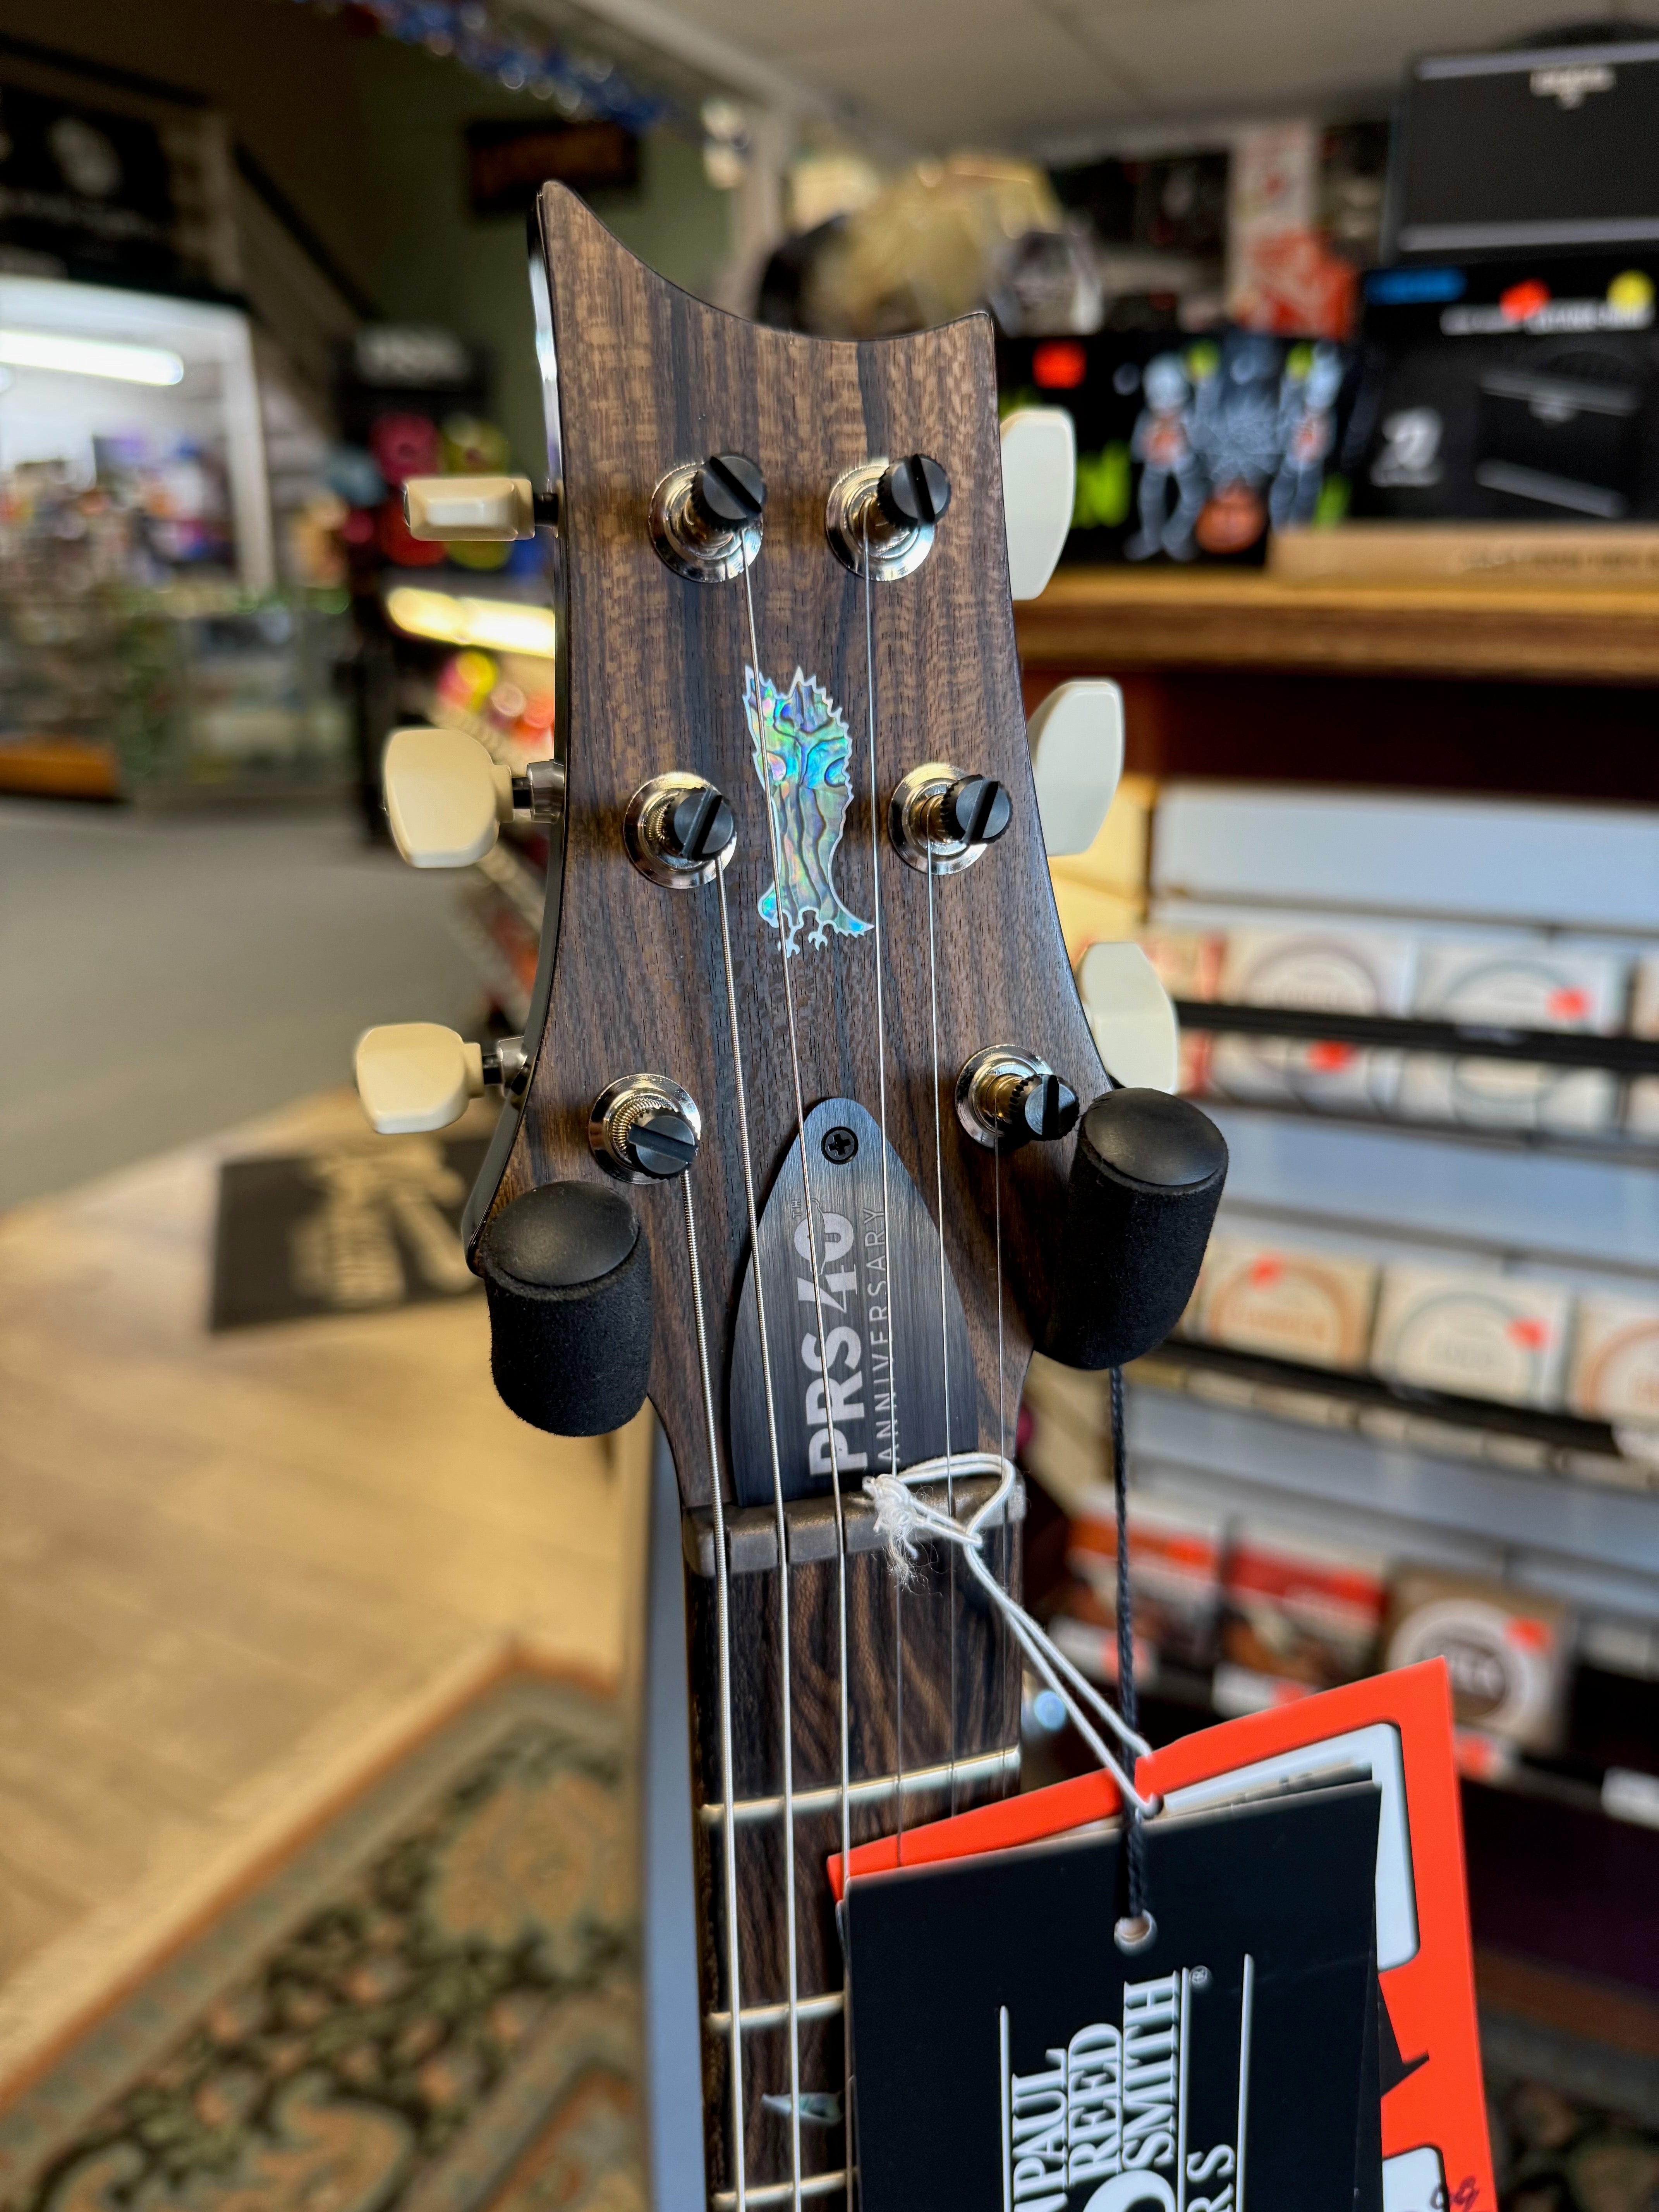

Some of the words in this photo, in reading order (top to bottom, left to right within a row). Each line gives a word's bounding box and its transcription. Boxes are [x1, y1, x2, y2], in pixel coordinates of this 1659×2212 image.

[801, 1326, 868, 1476] PRS
[863, 1207, 900, 1463] ANNIVERSARY
[1011, 2047, 1069, 2202] PAUL
[1068, 2022, 1123, 2191] REED
[1123, 1970, 1180, 2170] SMITH
